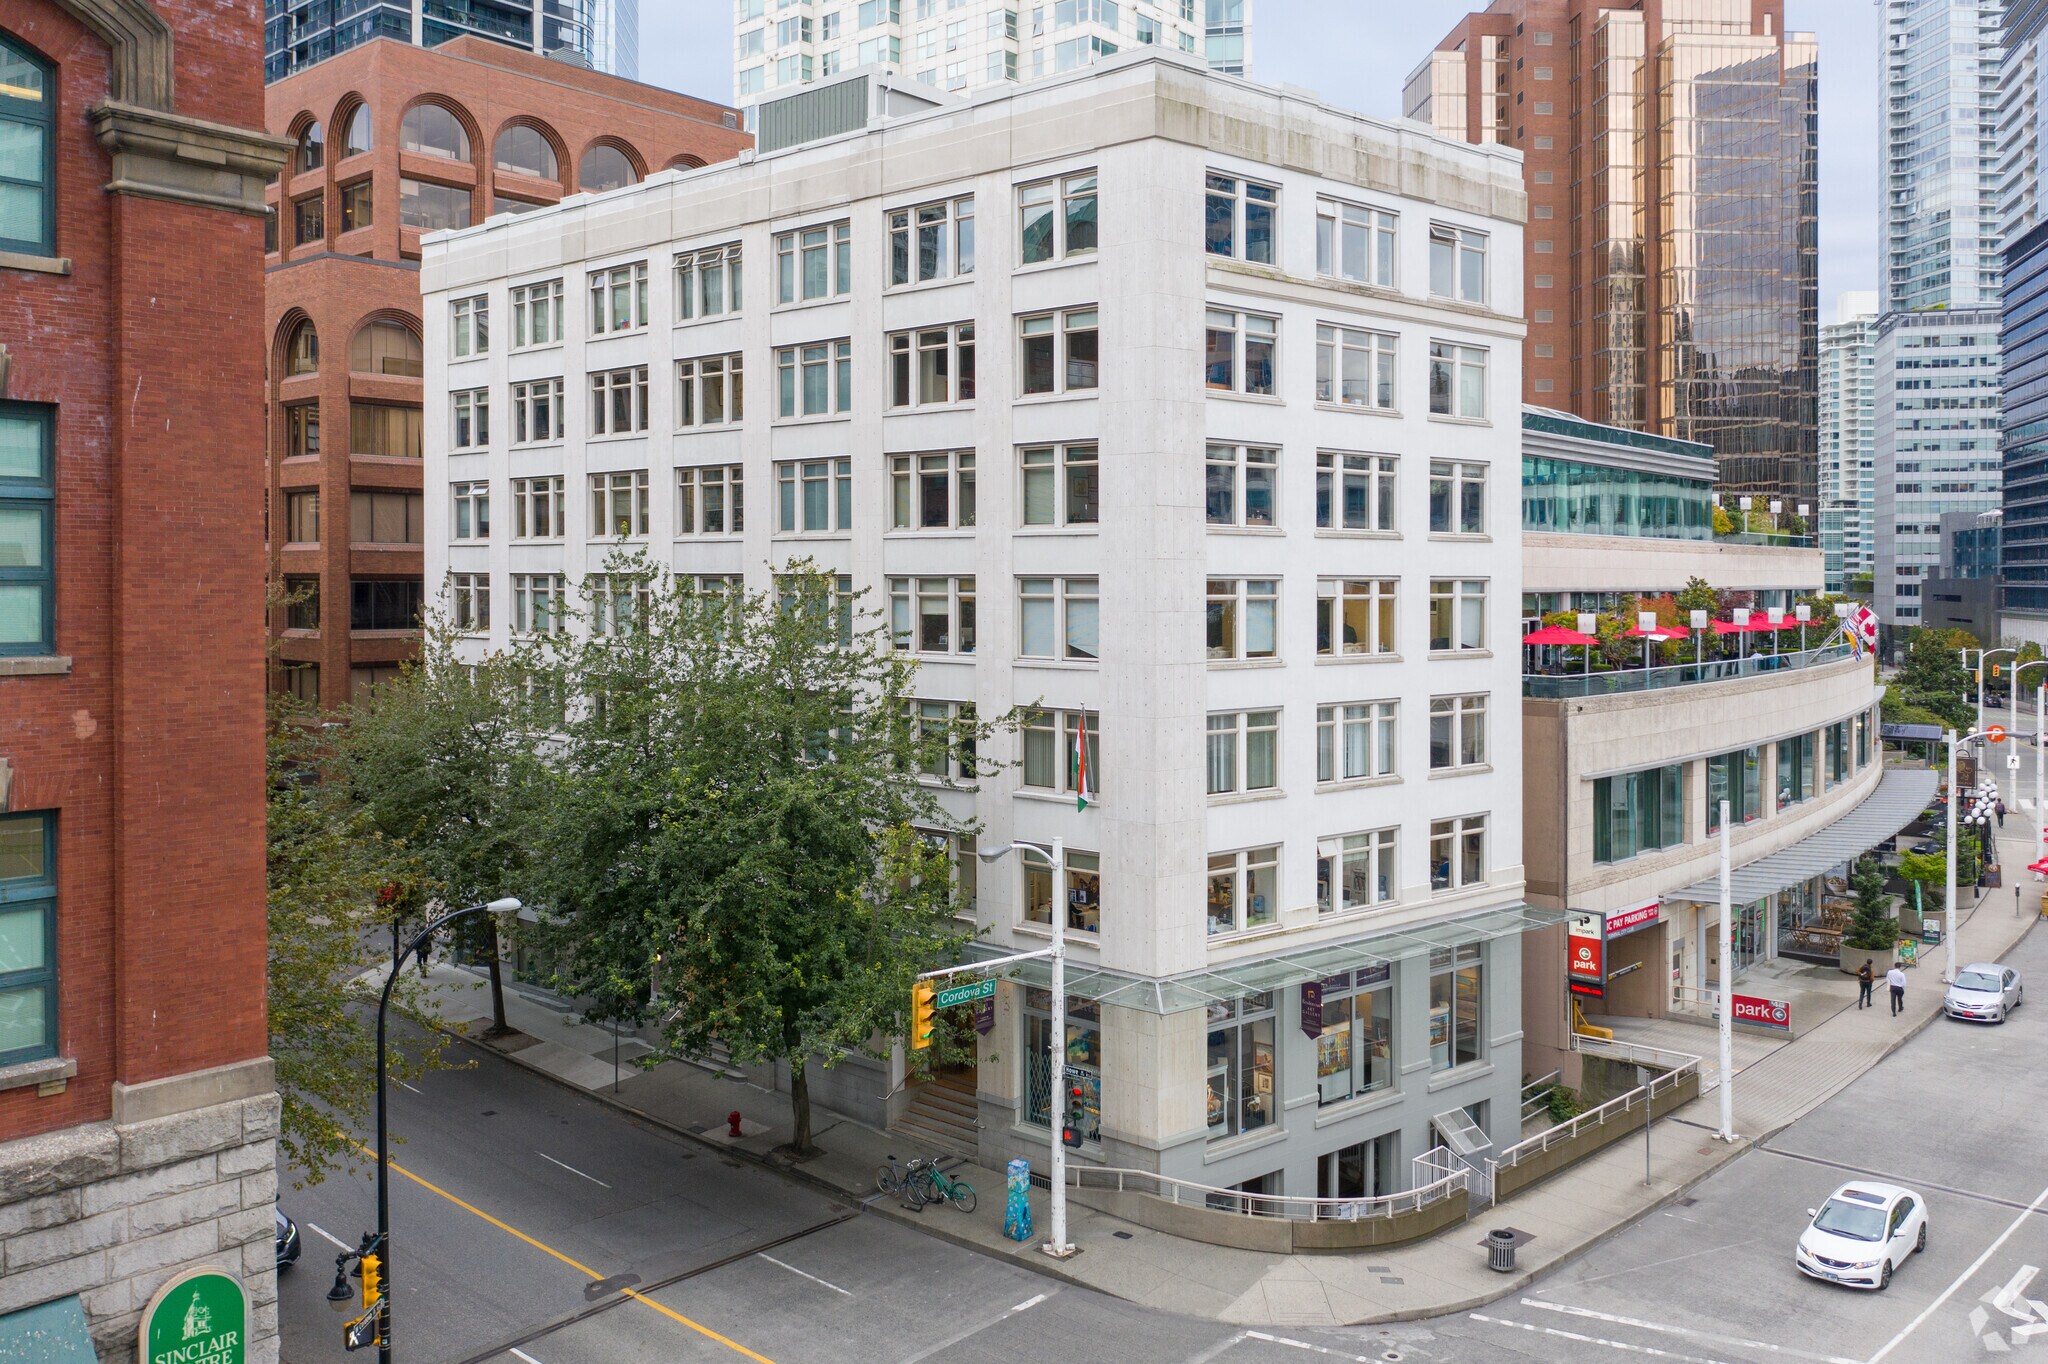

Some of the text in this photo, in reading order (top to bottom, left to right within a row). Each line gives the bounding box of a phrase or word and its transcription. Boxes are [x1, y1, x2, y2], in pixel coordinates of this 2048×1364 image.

[1613, 917, 1624, 929] PAY
[1624, 909, 1648, 925] PARKING
[1573, 960, 1596, 970] park
[941, 982, 993, 1004] Cordova St
[1735, 1003, 1770, 1019] park
[155, 1331, 238, 1364] SINCLAIR
